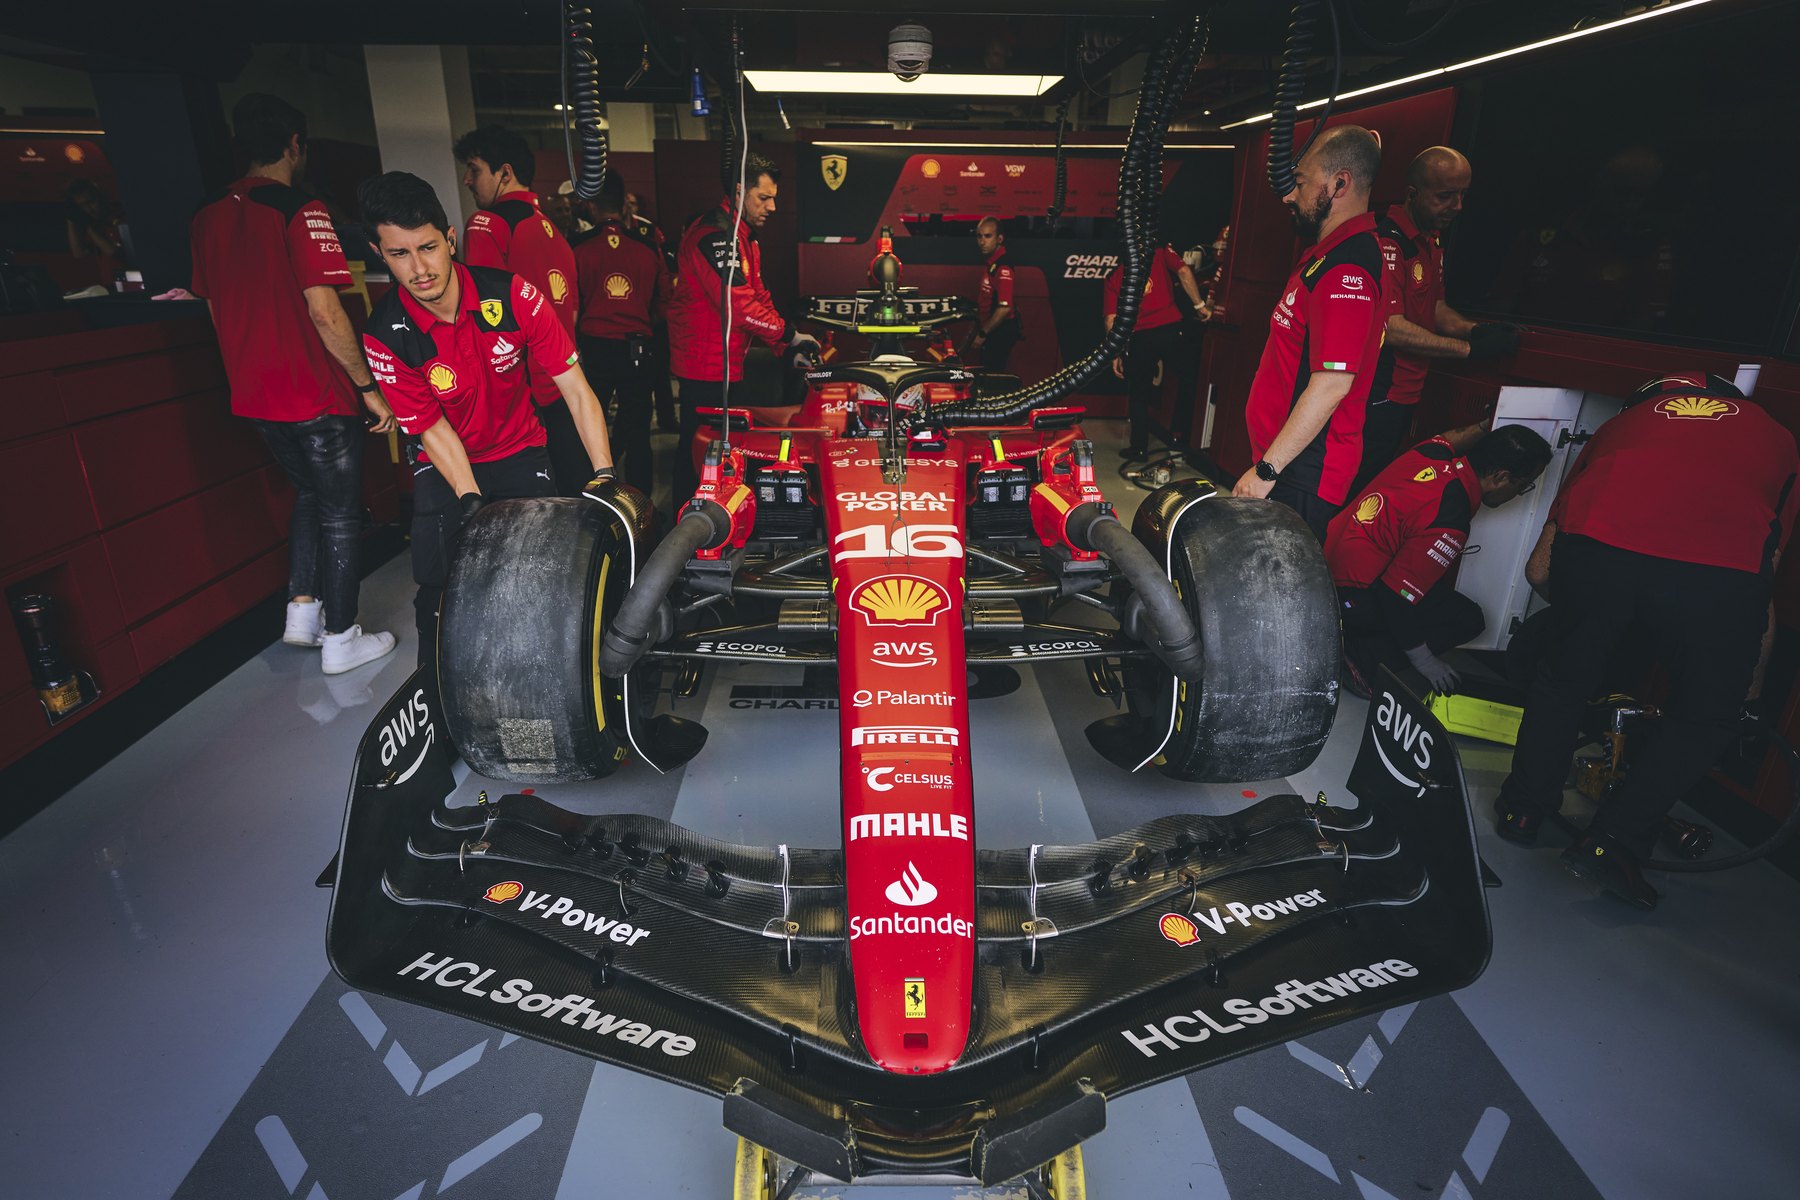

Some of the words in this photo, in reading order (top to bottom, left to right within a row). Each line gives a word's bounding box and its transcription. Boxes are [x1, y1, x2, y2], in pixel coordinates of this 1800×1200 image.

[1005, 165, 1025, 173] VGW
[520, 281, 532, 299] aws
[1342, 275, 1363, 285] aws
[836, 491, 956, 502] GLOBAL
[845, 501, 948, 511] POKER
[835, 524, 964, 564] 16
[717, 642, 787, 653] ECOPOL
[873, 642, 934, 656] aws
[1028, 641, 1100, 652] ECOPOL
[877, 690, 957, 706] Palantir
[379, 688, 429, 766] aws
[852, 725, 959, 747] PIRELLI
[1377, 691, 1434, 770] aws
[894, 773, 953, 785] CELSIUS
[850, 812, 968, 842] MAHLE
[518, 890, 650, 947] V-Power
[1193, 888, 1327, 935] V-Power
[850, 912, 974, 940] Santander
[396, 951, 697, 1058] HCLSoftware
[1120, 958, 1420, 1058] HCLSoftware
